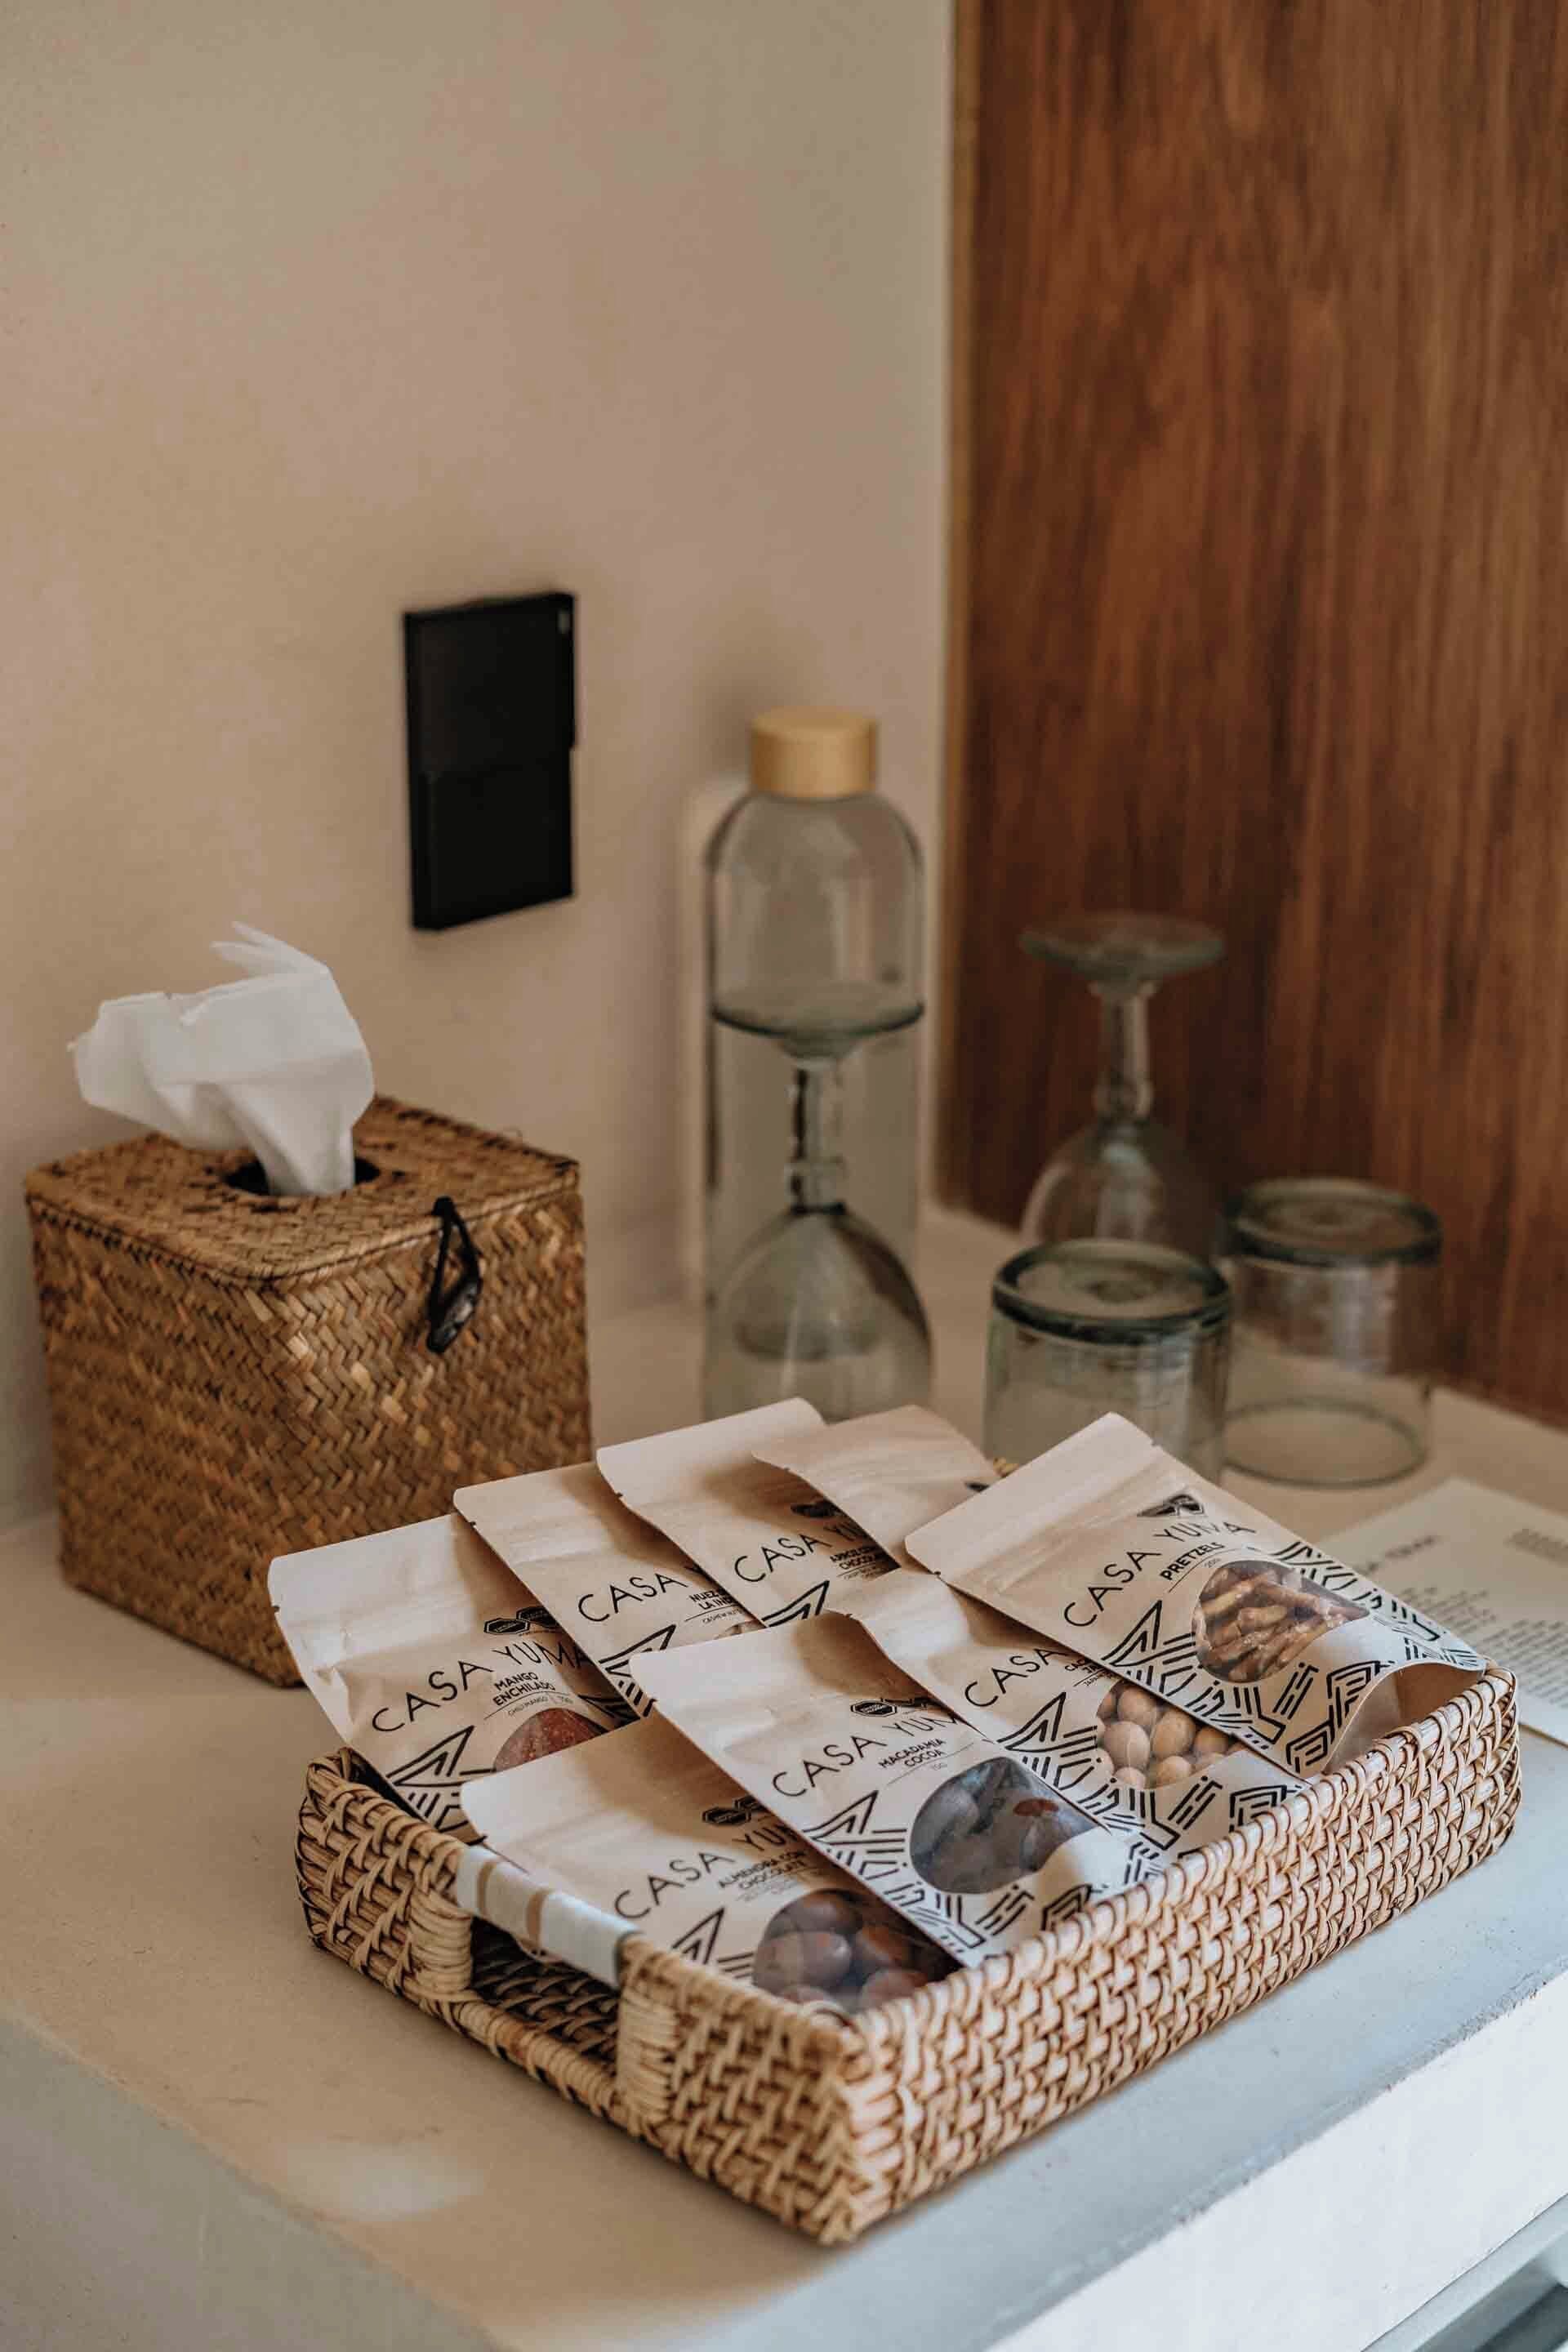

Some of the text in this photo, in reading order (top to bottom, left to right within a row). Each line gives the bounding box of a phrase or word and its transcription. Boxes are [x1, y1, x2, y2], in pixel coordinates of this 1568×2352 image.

[734, 1533, 833, 1583] CASA
[1159, 1541, 1226, 1581] PRETZELS
[577, 1572, 689, 1622] CASA
[1063, 1551, 1162, 1627] CASA
[372, 1660, 494, 1732] CASA
[492, 1681, 556, 1706] ENCHILADO
[493, 1671, 539, 1691] MANGO
[964, 1647, 1071, 1707] CASA
[772, 1716, 959, 1797] CASA YUM
[877, 1738, 947, 1769] MACADAMIA
[903, 1748, 947, 1767] COCOA
[614, 1851, 735, 1919] CASA
